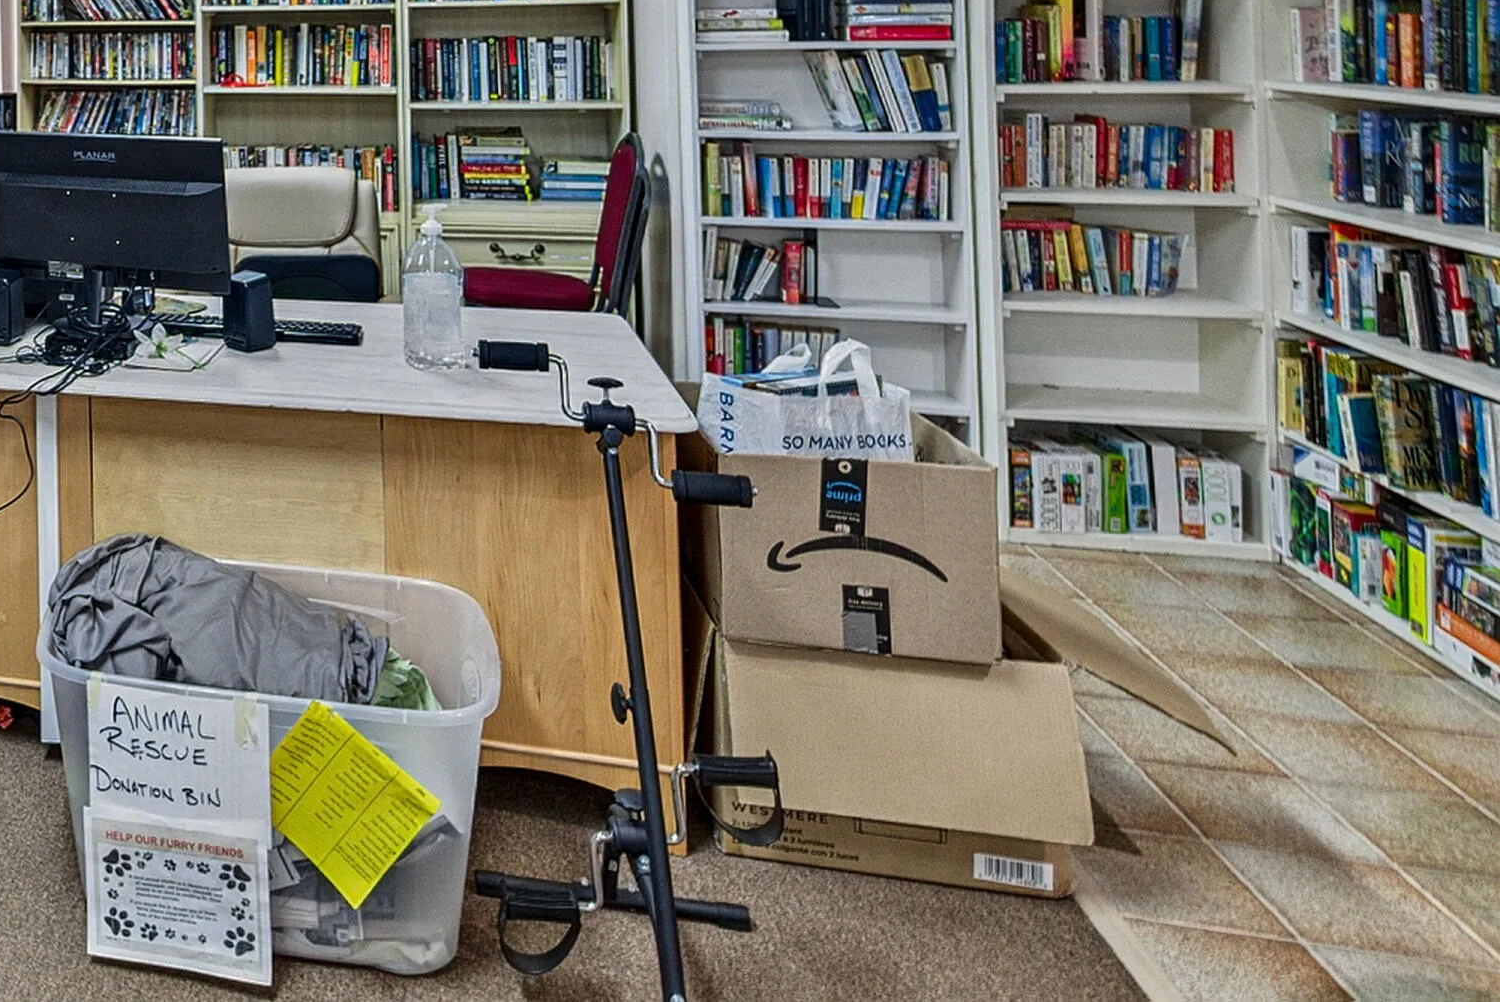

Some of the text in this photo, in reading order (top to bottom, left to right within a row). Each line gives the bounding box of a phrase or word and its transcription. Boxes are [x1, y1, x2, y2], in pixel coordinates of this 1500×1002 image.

[73, 150, 116, 160] PLANAR
[782, 436, 804, 450] SO
[809, 435, 852, 450] MANY
[826, 491, 862, 504] prime
[112, 697, 216, 740] ANIMAL
[99, 727, 208, 766] RESCUE
[89, 764, 222, 809] DONATION BIN
[731, 801, 829, 825] WESMERE
[104, 830, 245, 860] HELP OUR FURRY FRIENDS
